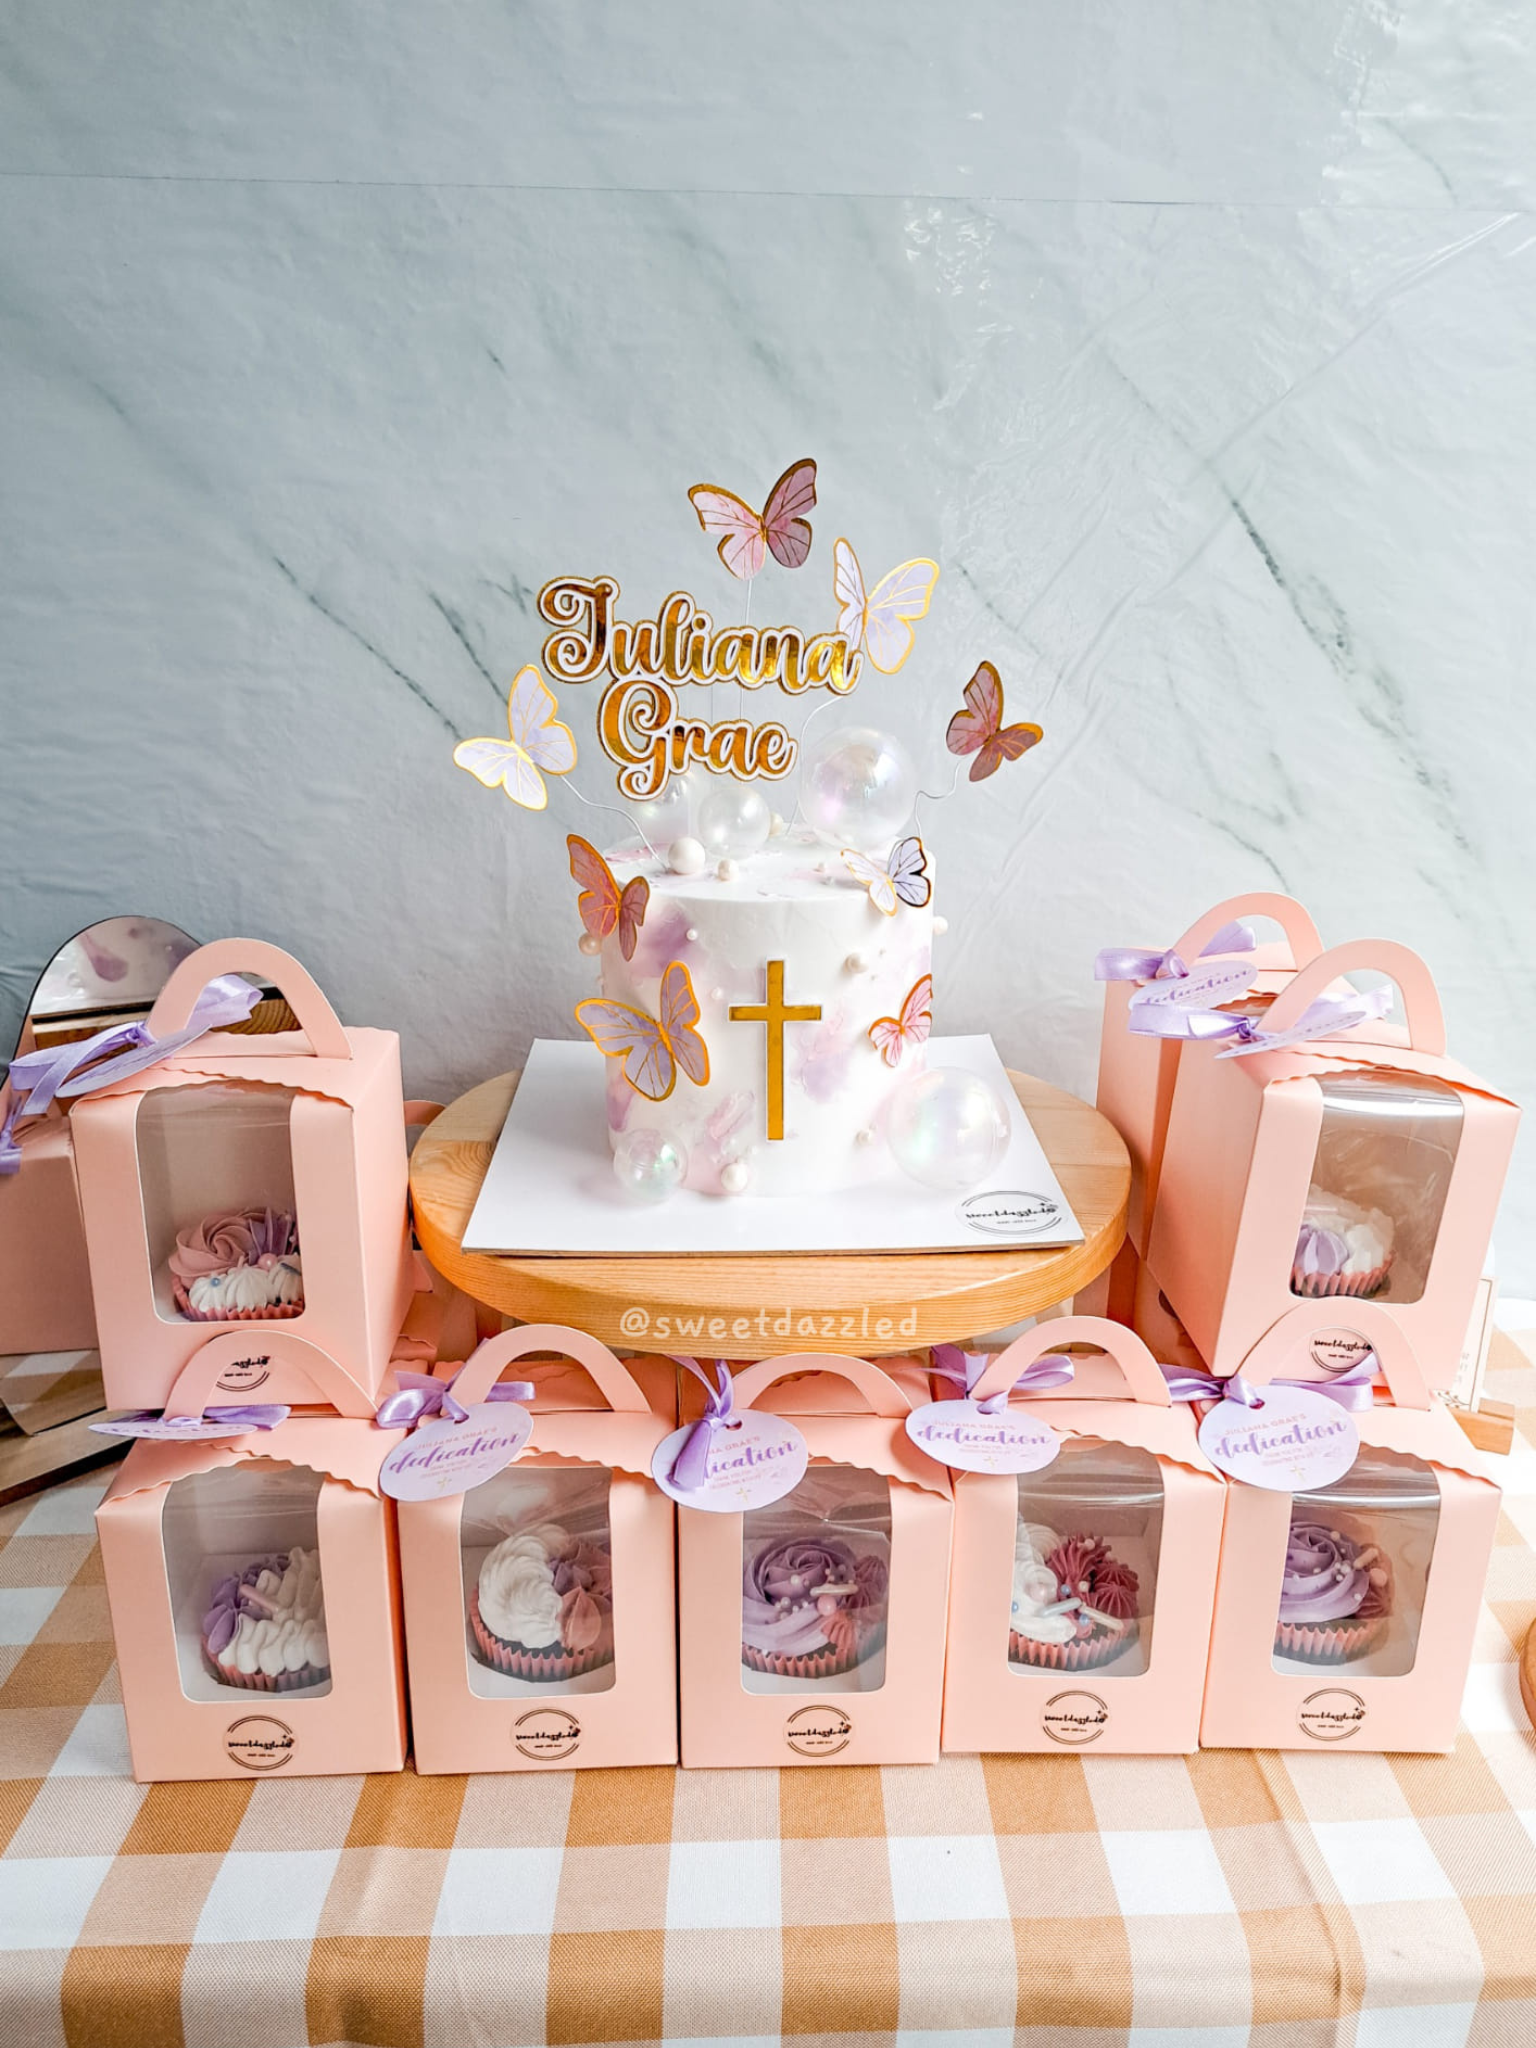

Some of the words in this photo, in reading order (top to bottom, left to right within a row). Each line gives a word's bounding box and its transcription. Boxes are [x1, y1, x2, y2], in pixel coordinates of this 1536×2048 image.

[537, 575, 864, 695] Juliana
[597, 679, 798, 801] Grae
[388, 1432, 519, 1474] dedication
[917, 1425, 1051, 1445] dedication
[1214, 1420, 1347, 1459] dedication
[704, 1441, 799, 1479] ication
